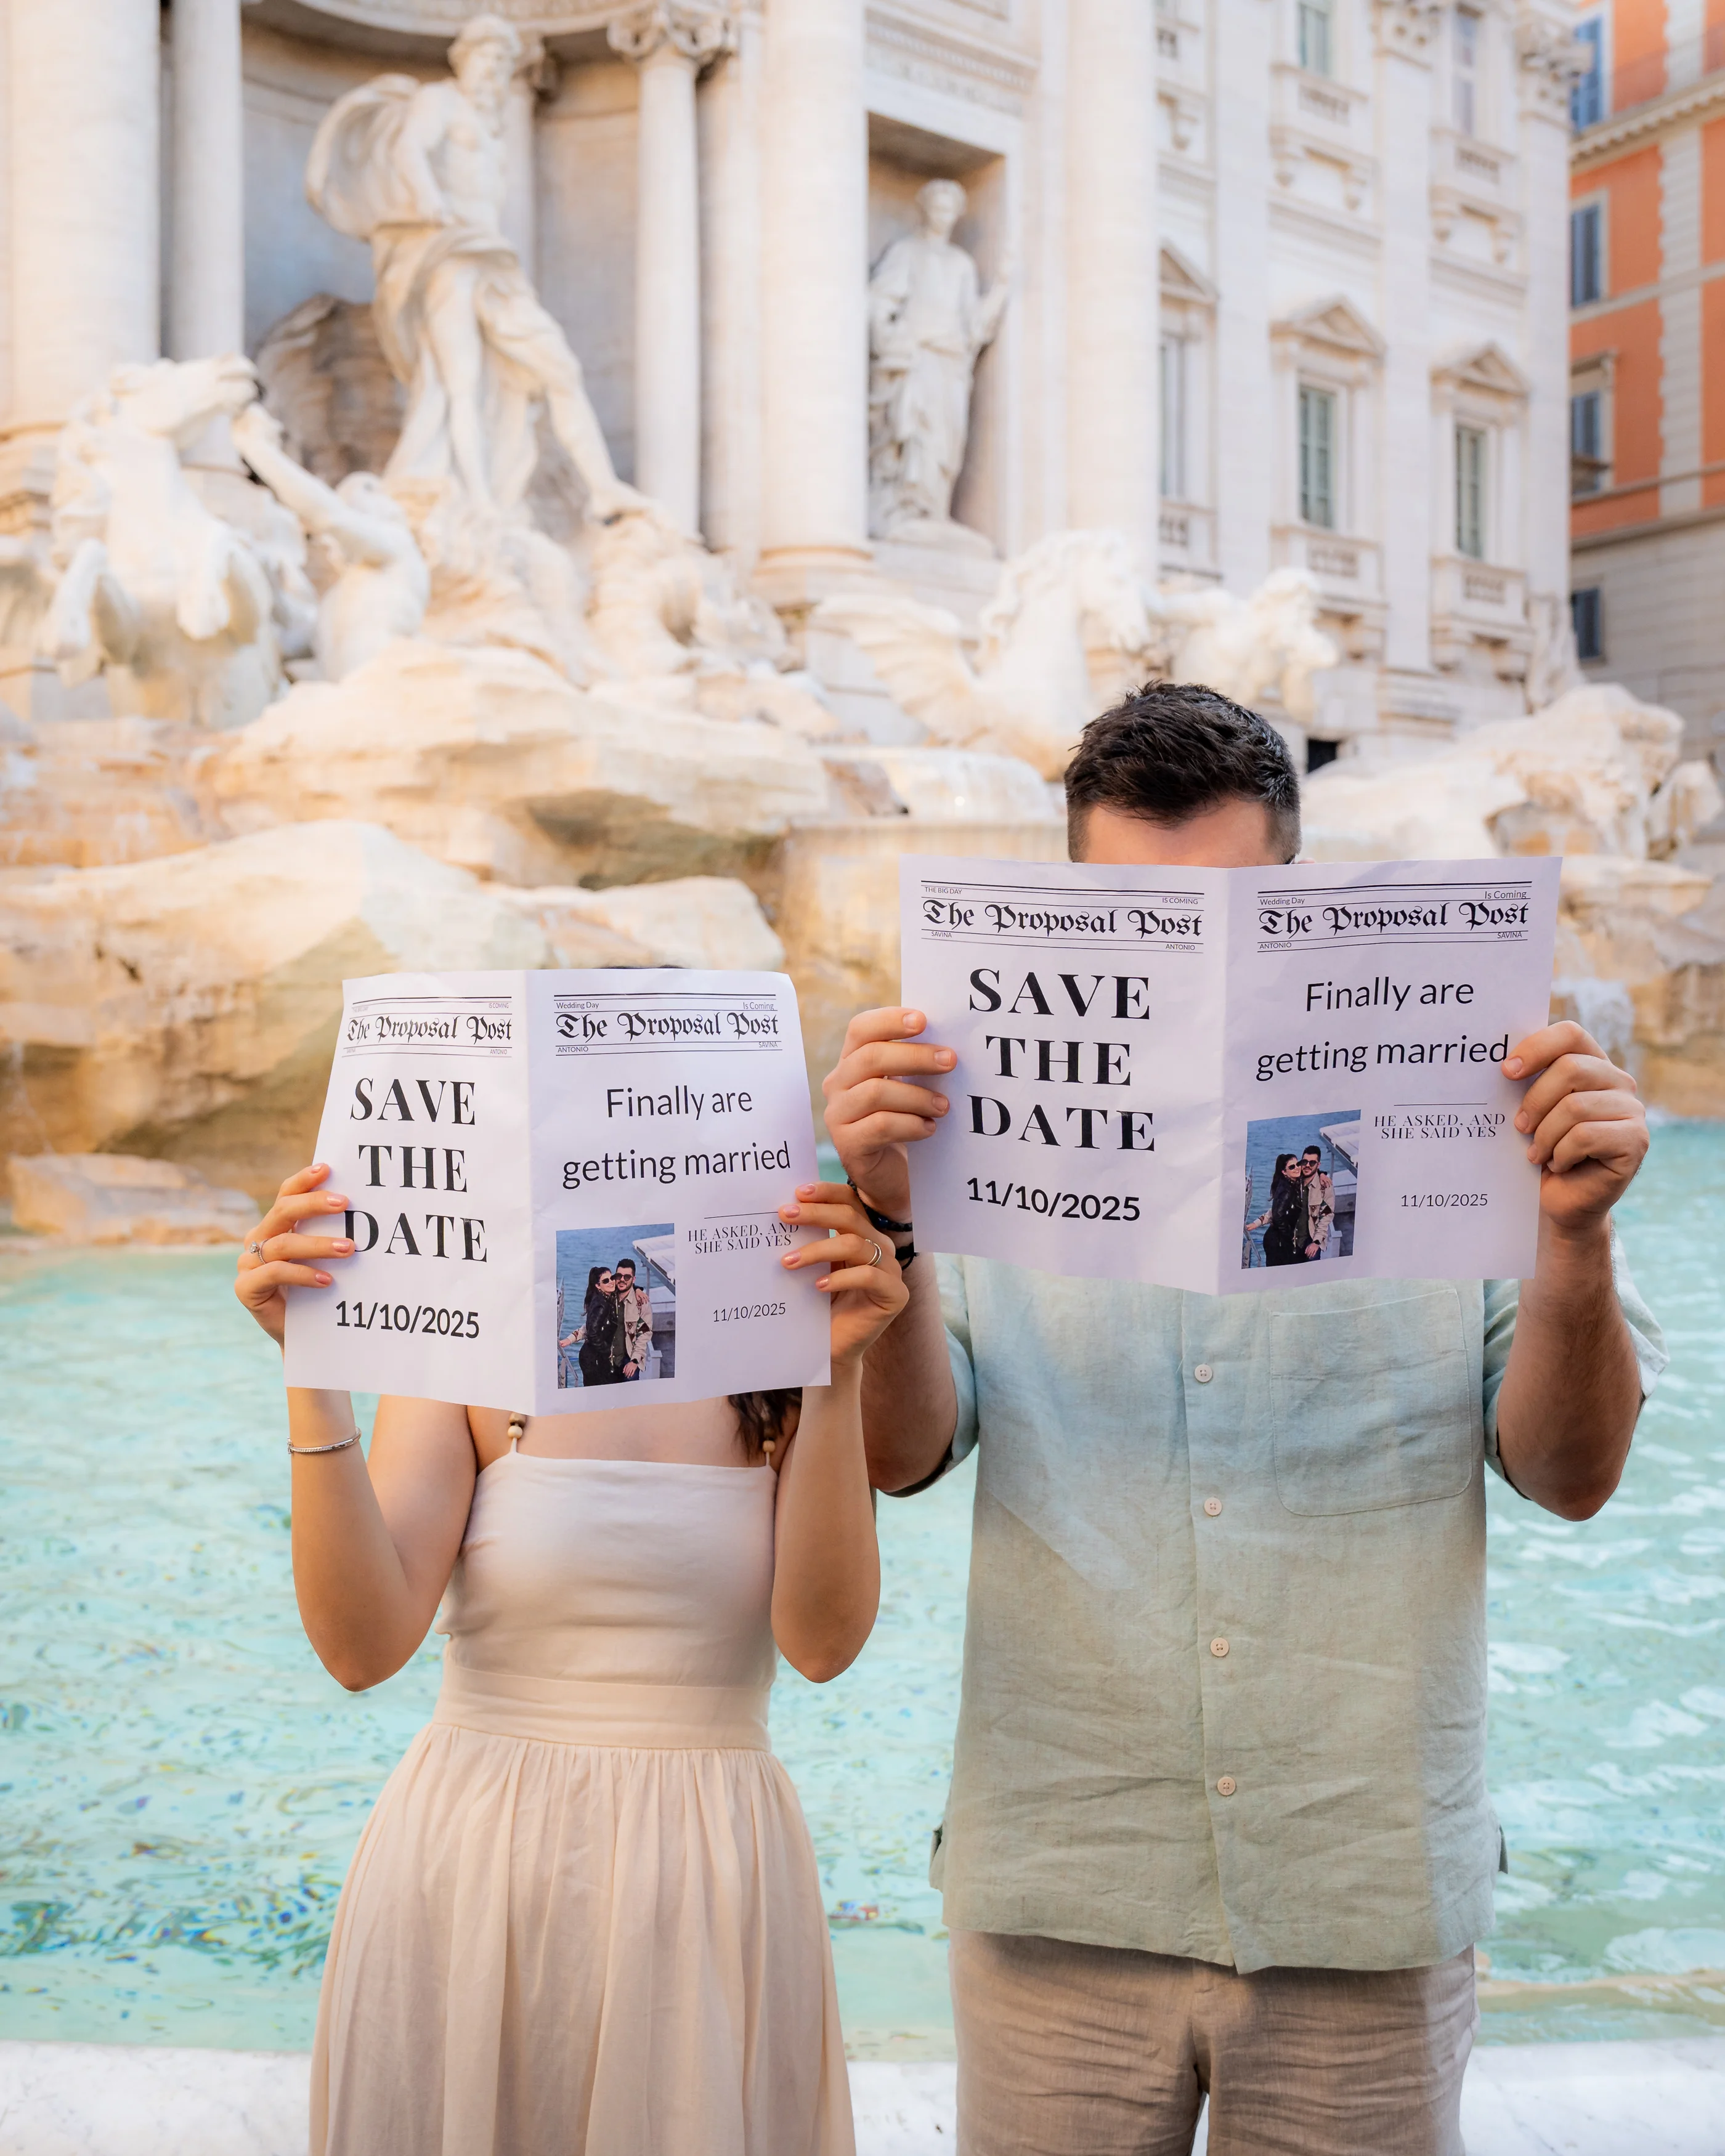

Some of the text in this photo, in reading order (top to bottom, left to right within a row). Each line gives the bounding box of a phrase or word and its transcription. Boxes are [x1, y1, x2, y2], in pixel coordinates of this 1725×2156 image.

[1169, 897, 1198, 905] COMING
[1259, 897, 1305, 906] Wedding Day
[1484, 890, 1527, 899] Is Coming
[923, 899, 1203, 939] The Proposal Post
[1259, 902, 1528, 939] The Proposal Post
[1497, 931, 1522, 939] SAVINA
[556, 1001, 599, 1010] Wedding Day
[743, 1002, 774, 1011] Is Coming
[969, 968, 1150, 1020] SAVE
[1306, 976, 1474, 1012] Finally are
[347, 1015, 512, 1045] The Proposal Post
[556, 1011, 779, 1043] The Proposal Post
[986, 1035, 1130, 1086] THE
[1256, 1034, 1509, 1082] getting married
[350, 1077, 476, 1125] SAVE
[606, 1085, 752, 1121] Finally are
[967, 1094, 1155, 1152] DATE
[1374, 1113, 1506, 1127] HE ASKED, AND
[1381, 1126, 1496, 1139] SHE SAID YES
[358, 1144, 468, 1193] THE
[562, 1140, 791, 1190] getting married
[967, 1177, 1140, 1222] 11/10/2025
[1400, 1193, 1488, 1209] 11/10/2025
[344, 1209, 487, 1263] DATE
[688, 1228, 707, 1242] HE
[712, 1224, 763, 1239] ASKED,
[695, 1234, 792, 1254] SHE SAID YES
[335, 1300, 480, 1339] 11/10/2025
[713, 1302, 787, 1323] 11/10/2025
